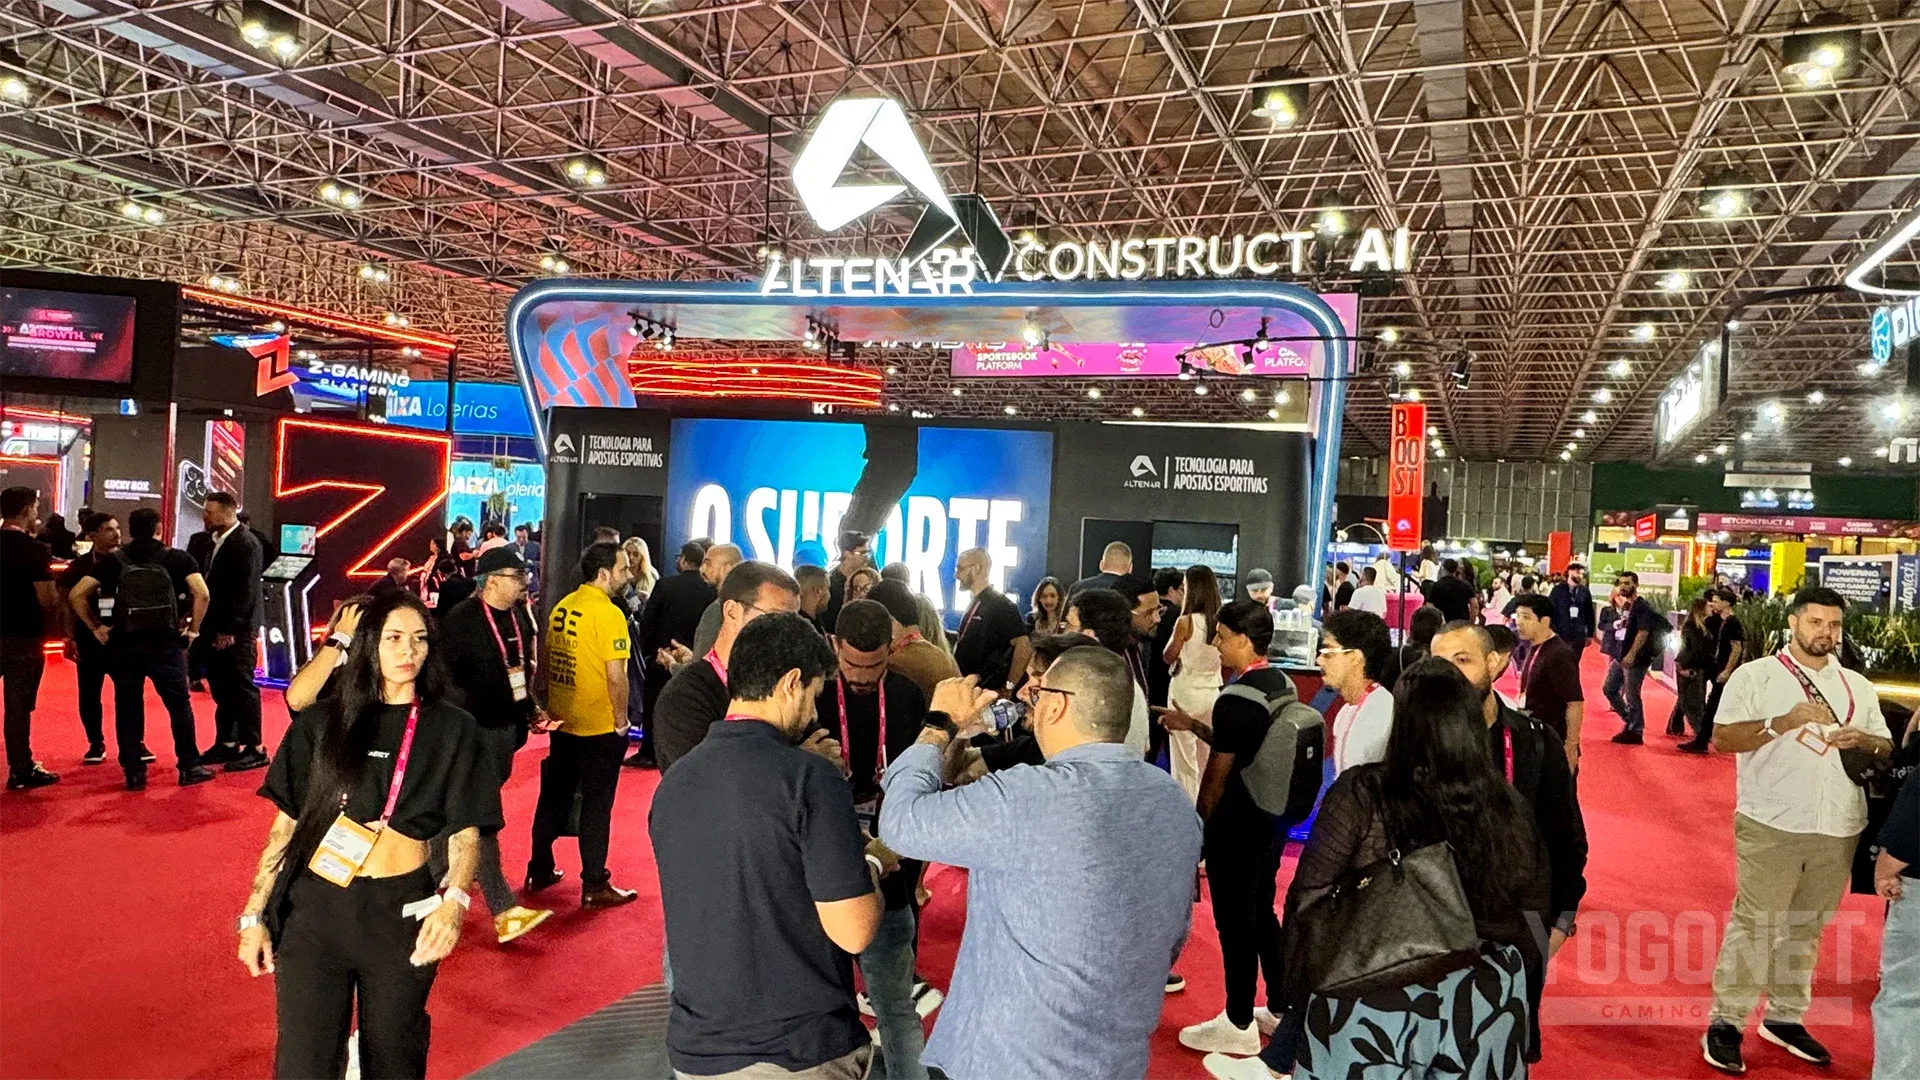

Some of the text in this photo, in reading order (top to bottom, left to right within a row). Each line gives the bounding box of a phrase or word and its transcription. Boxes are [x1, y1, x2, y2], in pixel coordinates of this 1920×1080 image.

[1351, 227, 1409, 271] AI
[761, 257, 975, 296] ALTENAR
[976, 352, 1038, 361] SPORTSBOOK
[1264, 357, 1306, 368] PLATFO
[308, 360, 410, 388] Z-GAMING
[976, 361, 1023, 371] PLATFORM
[320, 378, 399, 398] PLATFORM
[427, 396, 498, 420] Loerias
[589, 435, 653, 452] TECNOLOGIA PARA
[588, 451, 663, 468] APOSTAS ESPORTIVAS
[1174, 456, 1255, 476] TECNOLOGIA PARA
[104, 479, 150, 491] LUCKY BOX
[1123, 480, 1161, 489] ALTENAR
[1173, 474, 1269, 494] APOSTAS ESPORTIVAS
